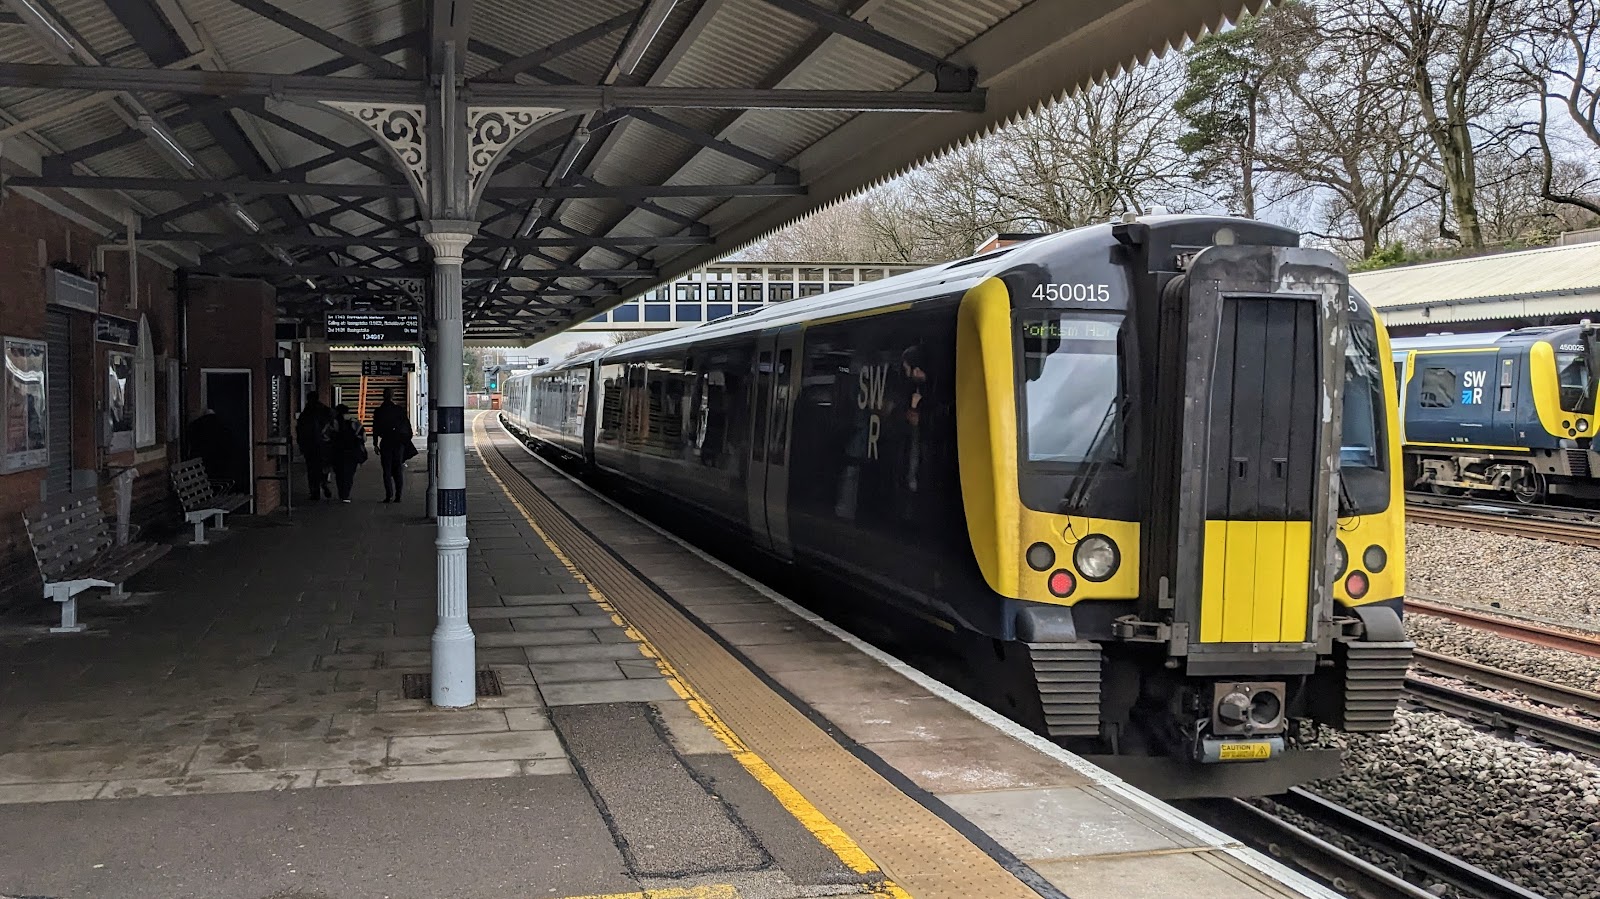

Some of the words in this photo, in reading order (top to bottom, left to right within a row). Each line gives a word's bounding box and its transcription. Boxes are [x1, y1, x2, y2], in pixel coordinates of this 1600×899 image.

[1031, 283, 1110, 302] 450015
[858, 363, 889, 410] SW
[1463, 370, 1487, 388] SW
[1473, 388, 1482, 404] R
[867, 414, 880, 460] R
